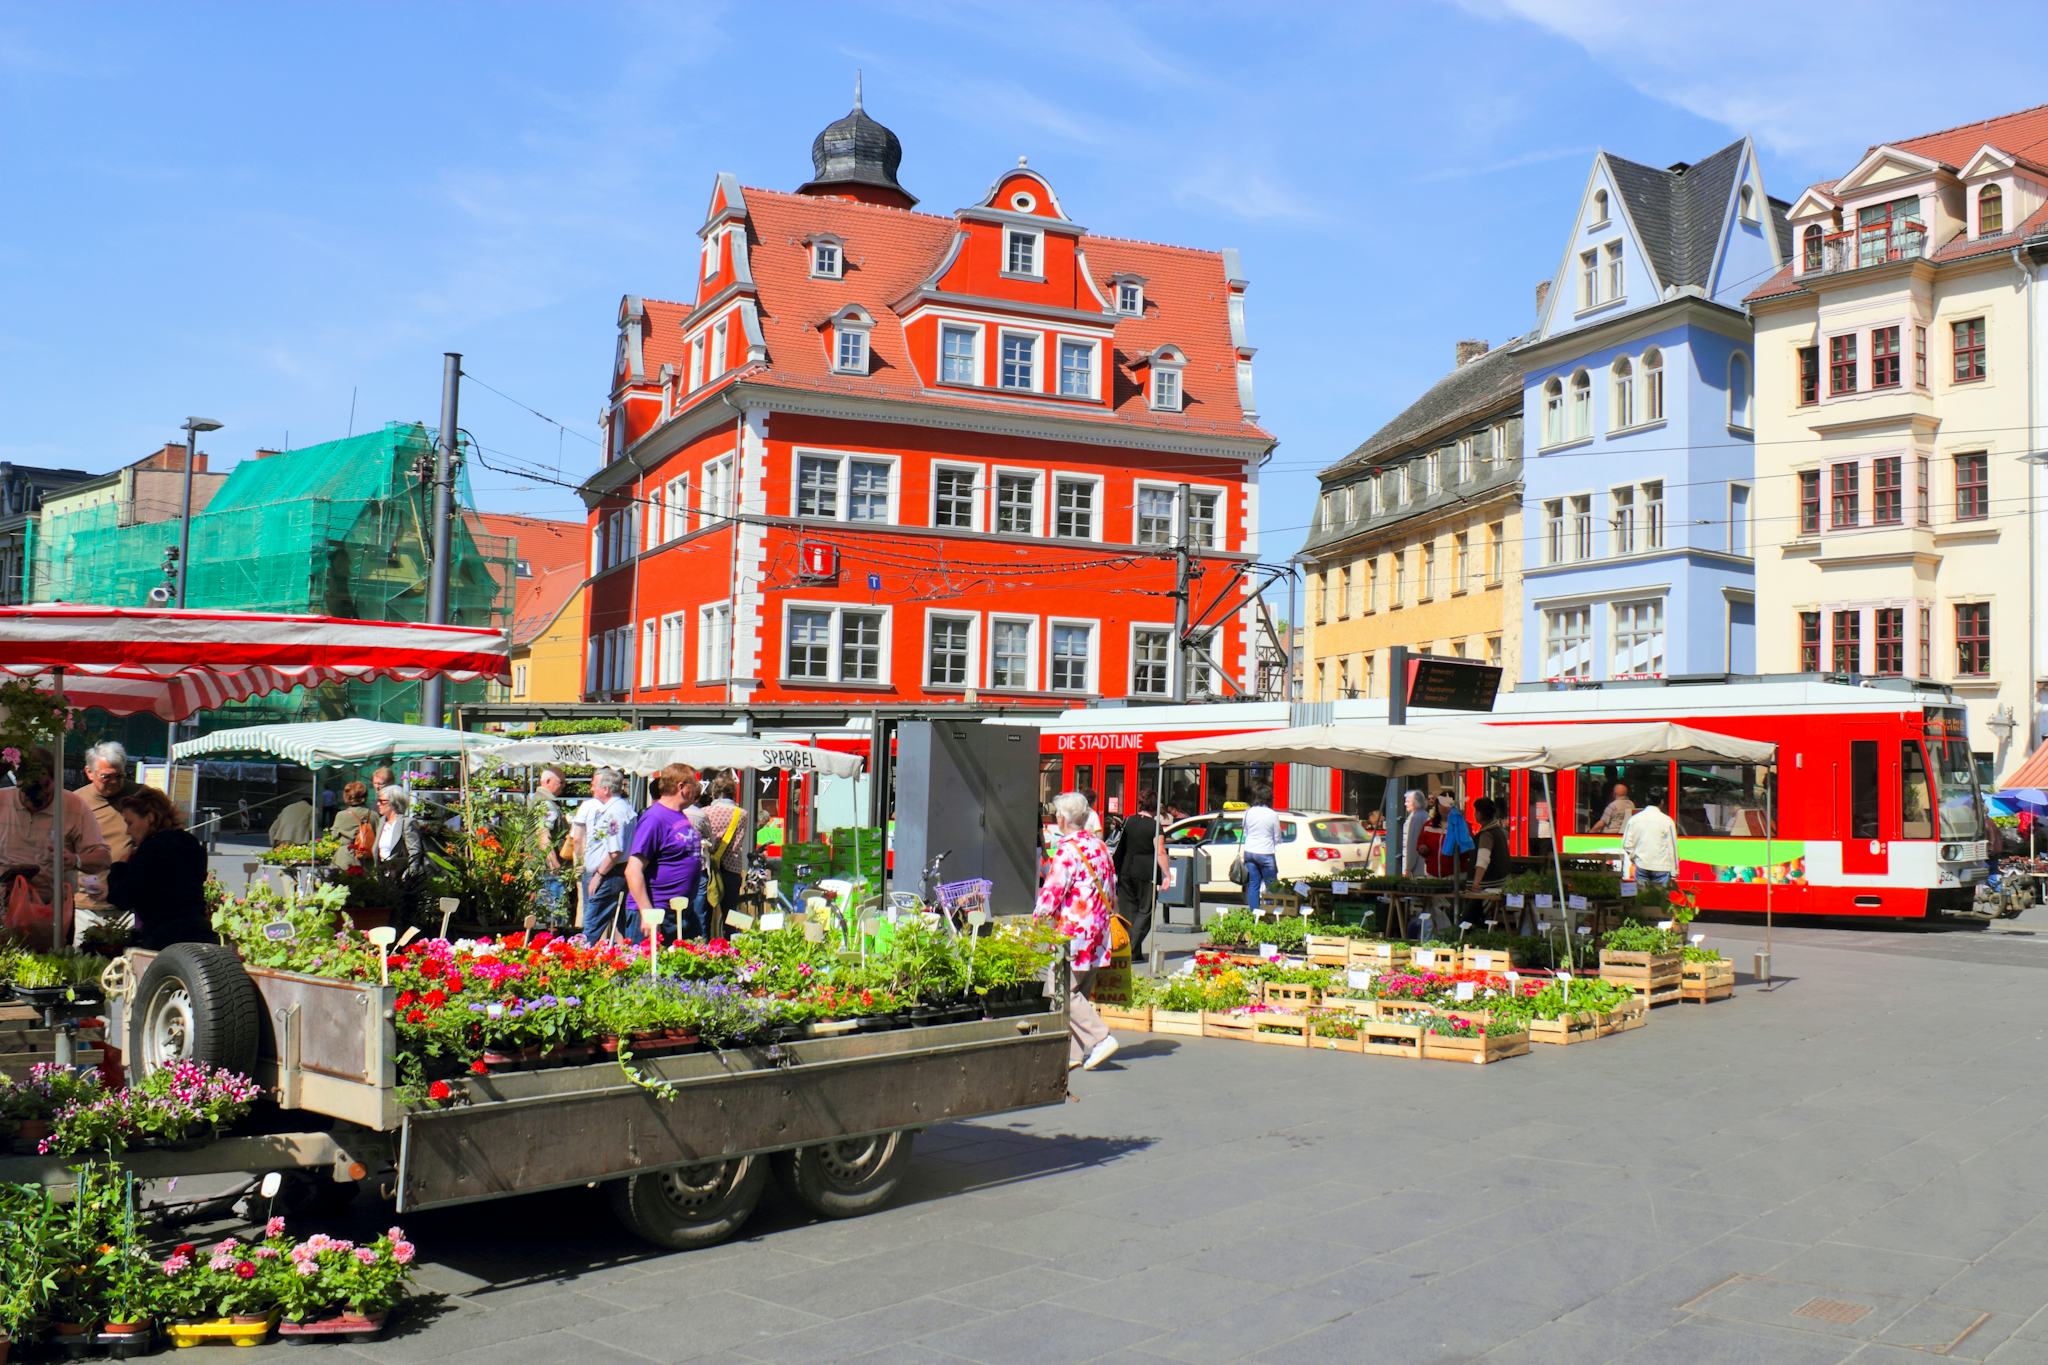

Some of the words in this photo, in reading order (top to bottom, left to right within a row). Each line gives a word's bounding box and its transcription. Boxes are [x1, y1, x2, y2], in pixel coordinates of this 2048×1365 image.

[869, 576, 879, 588] T
[1058, 735, 1076, 749] DIE
[1079, 733, 1143, 749] STADTLINIE
[553, 744, 591, 761] SPARGEL
[763, 749, 816, 768] SPARGEL
[1109, 960, 1128, 969] NU
